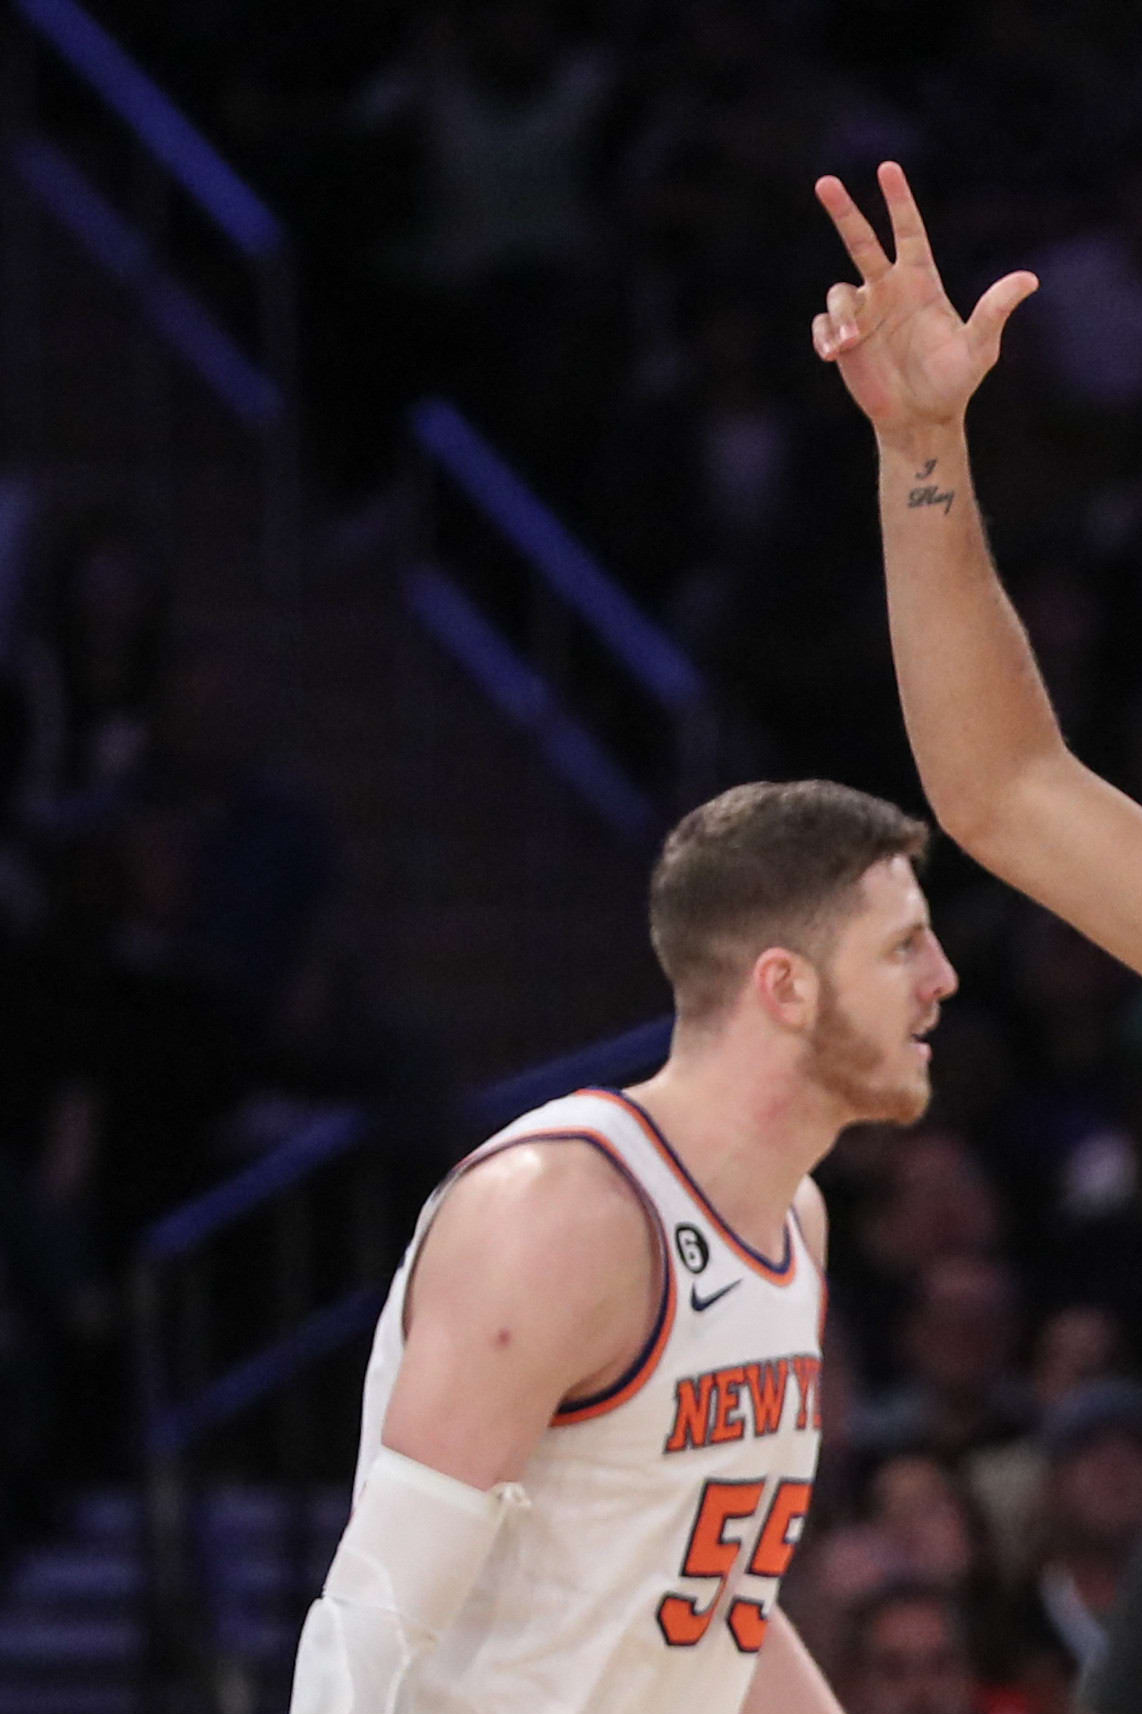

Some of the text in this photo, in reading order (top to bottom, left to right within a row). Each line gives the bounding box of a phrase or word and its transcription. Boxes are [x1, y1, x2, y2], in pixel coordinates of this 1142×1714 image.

[677, 1225, 706, 1271] 6
[664, 1358, 788, 1455] NEW
[656, 1478, 813, 1654] 55
